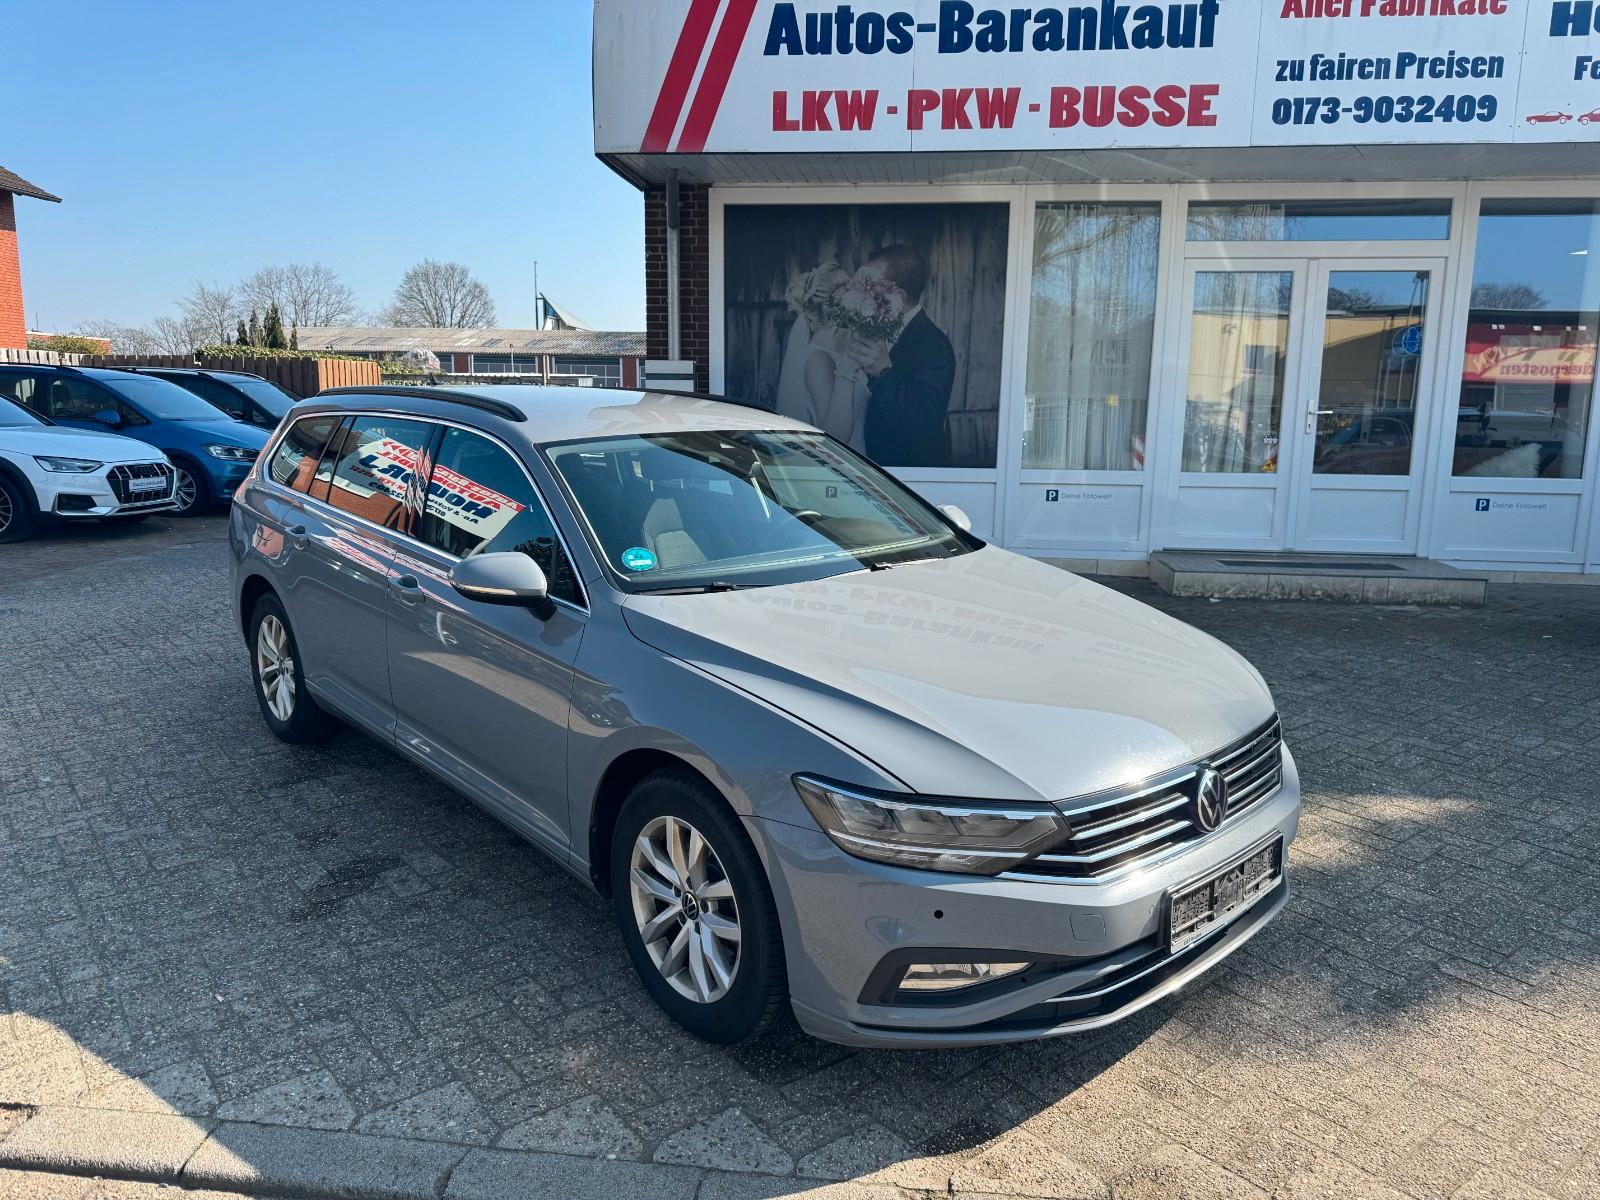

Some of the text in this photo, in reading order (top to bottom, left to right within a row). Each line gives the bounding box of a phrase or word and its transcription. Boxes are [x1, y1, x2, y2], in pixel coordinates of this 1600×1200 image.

[1359, 0, 1508, 17] Fabrikate
[1549, 0, 1600, 37] H
[763, 0, 1220, 56] Autos-Barankauf
[1275, 50, 1505, 82] zu fairen Preisen
[772, 89, 880, 132] LKW
[906, 87, 1022, 131] PKW
[1048, 84, 1220, 130] BUSSE
[1271, 94, 1498, 125] 0173-9032409
[1515, 502, 1547, 510] Fotowelt
